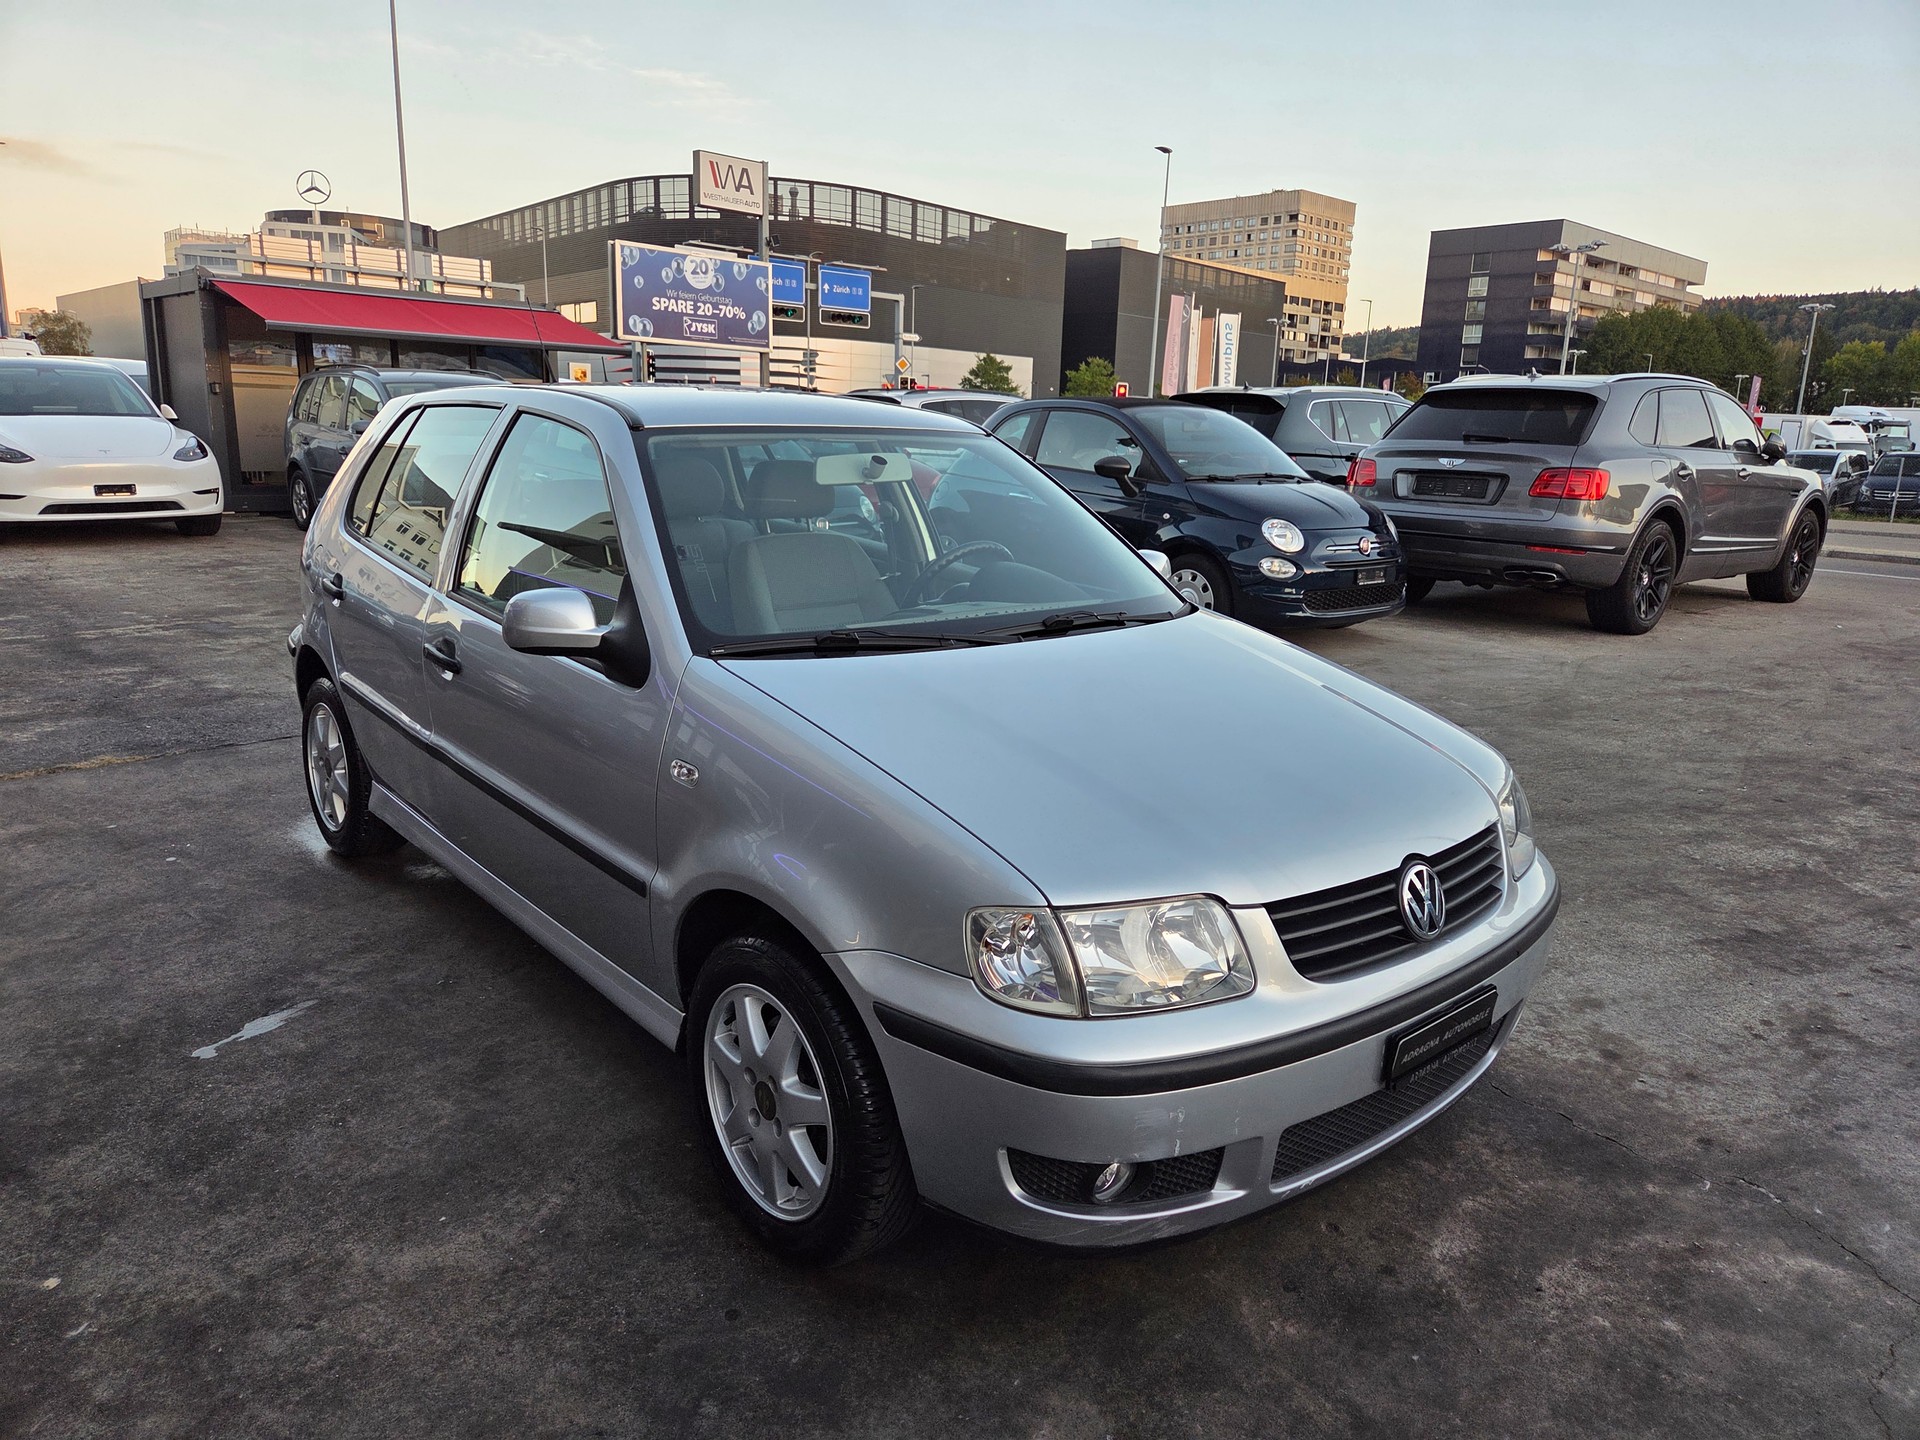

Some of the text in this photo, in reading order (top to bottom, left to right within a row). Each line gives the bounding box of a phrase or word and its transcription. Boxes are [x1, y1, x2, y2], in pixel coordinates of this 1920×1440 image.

[690, 259, 709, 275] 20
[666, 288, 733, 306] Wir feiern Geburtstag
[833, 284, 850, 294] Zürich
[652, 296, 694, 314] SPARE
[690, 322, 716, 334] JYSK
[1401, 1007, 1491, 1065] ADRAGNA AUTOMOBILE
